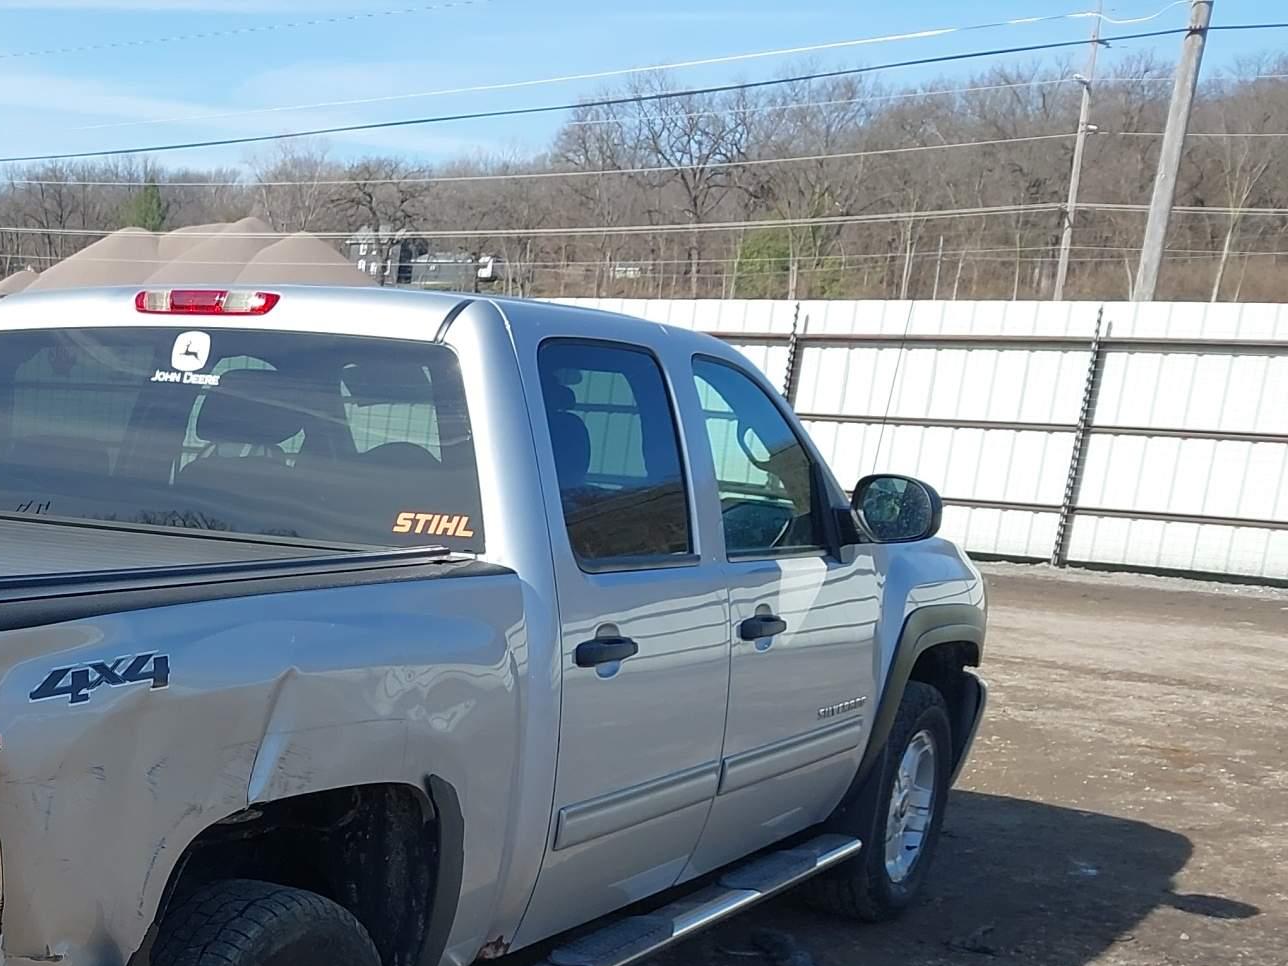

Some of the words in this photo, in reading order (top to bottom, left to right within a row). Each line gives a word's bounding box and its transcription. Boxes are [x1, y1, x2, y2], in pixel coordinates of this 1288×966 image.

[151, 369, 181, 383] JOHN
[183, 372, 220, 385] DEERE
[392, 512, 474, 537] STIHL
